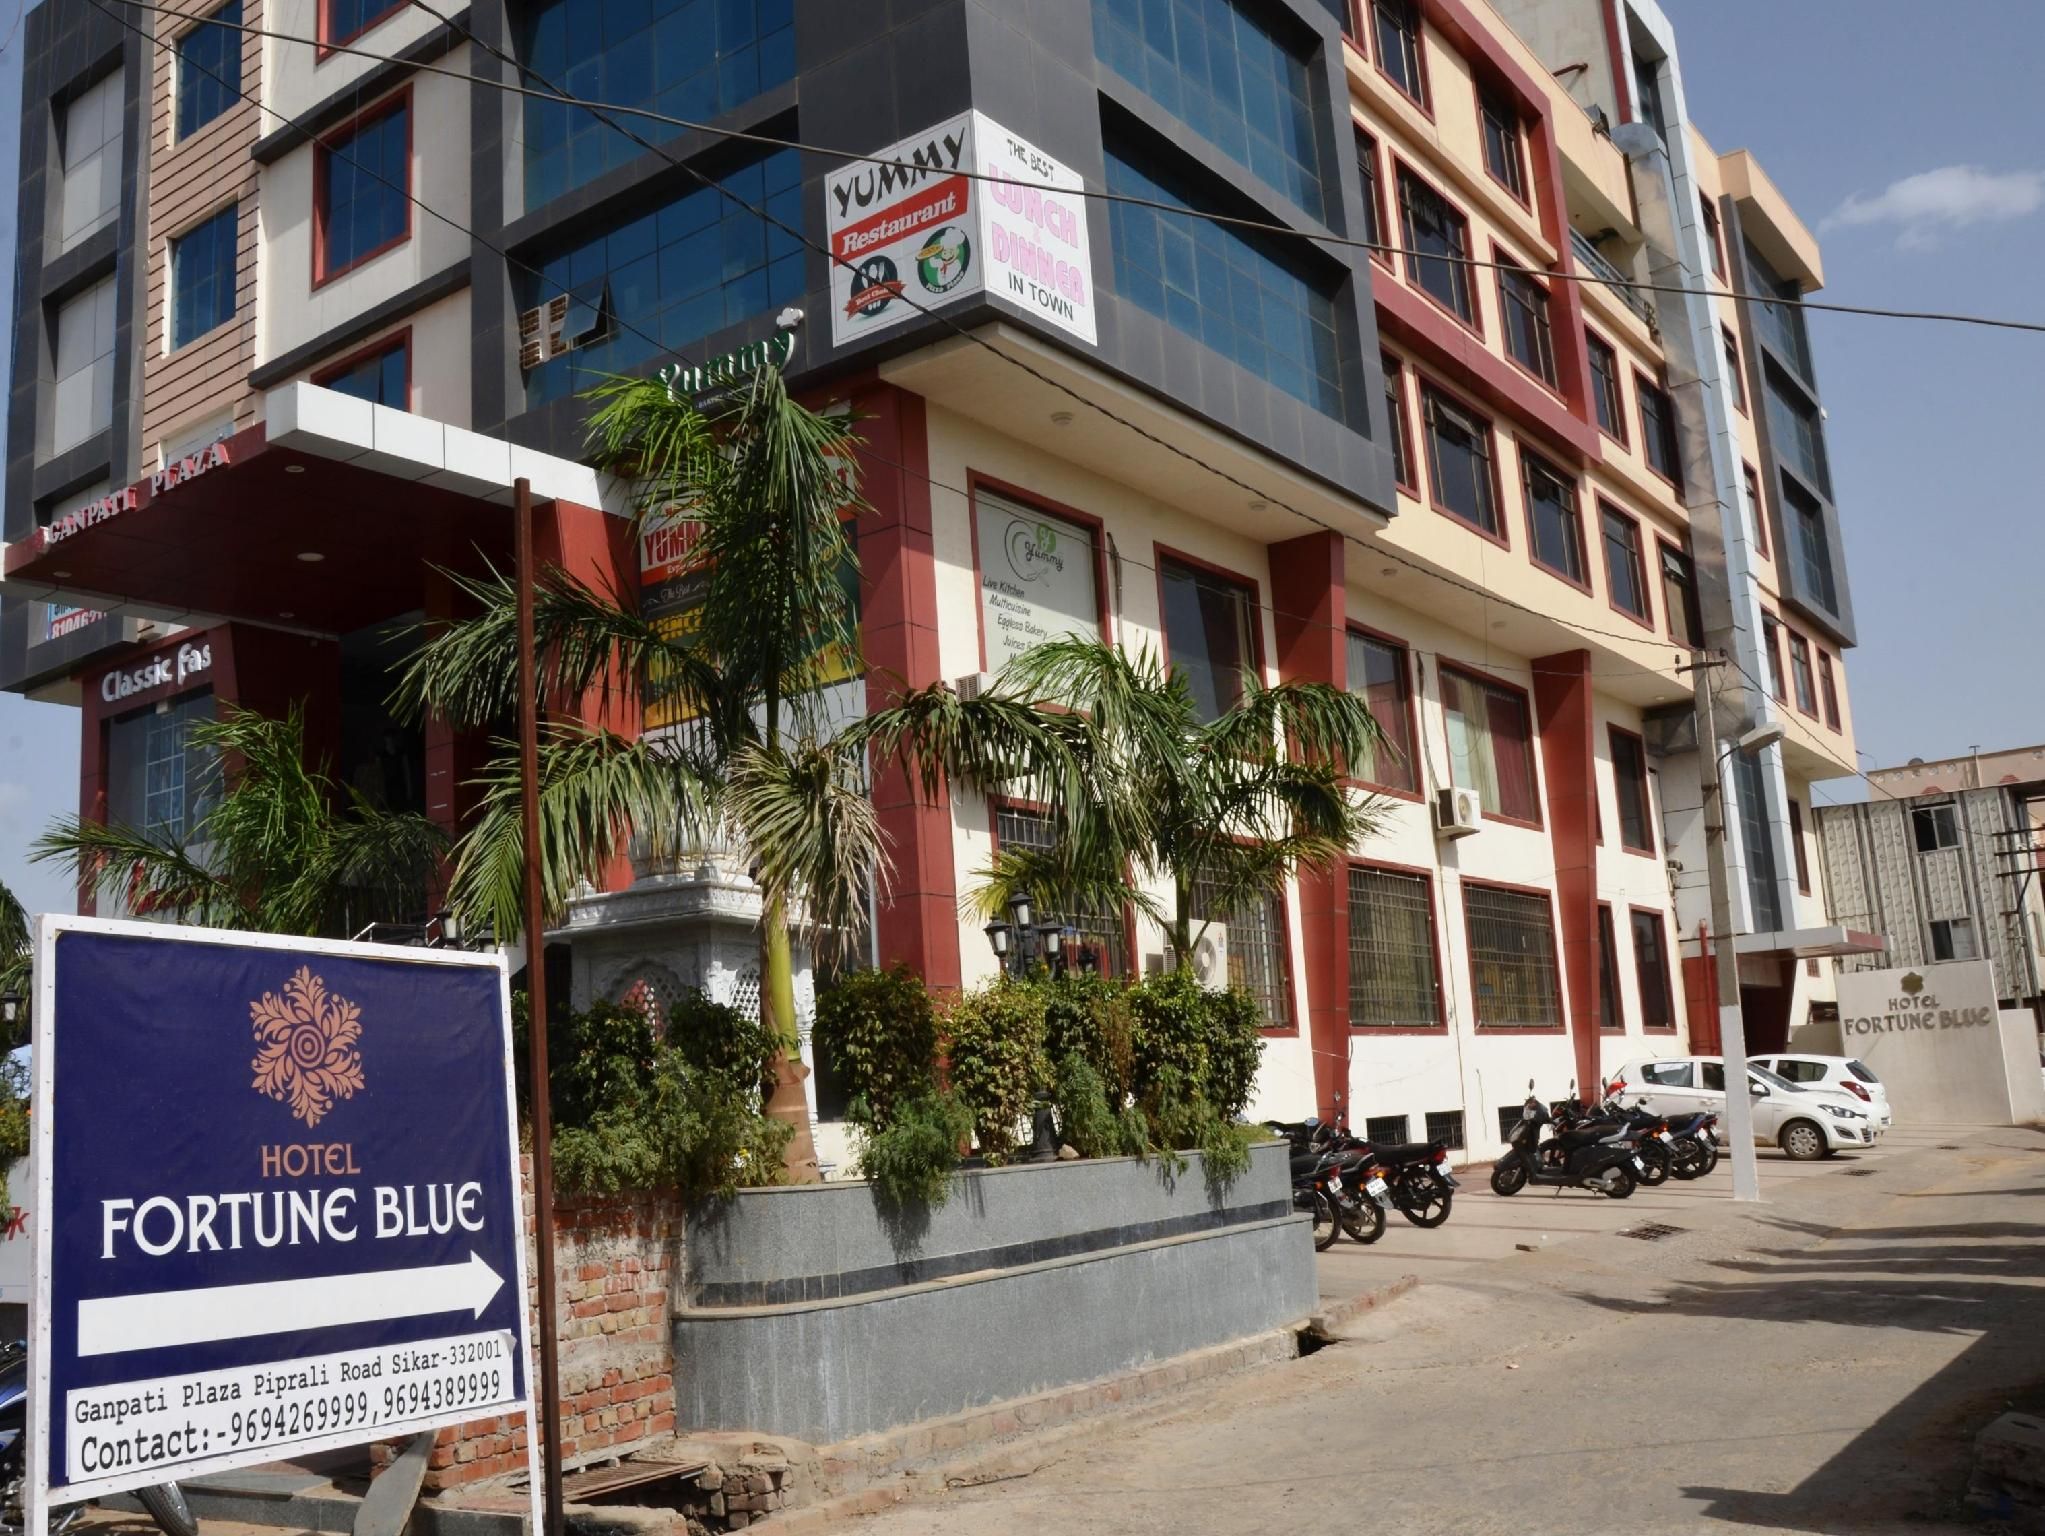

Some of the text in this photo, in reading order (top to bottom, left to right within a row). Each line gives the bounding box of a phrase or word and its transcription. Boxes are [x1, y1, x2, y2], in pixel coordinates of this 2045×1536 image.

[833, 127, 965, 218] YUMMY
[1007, 138, 1054, 181] THE BEST
[841, 191, 956, 256] Restaurant
[988, 163, 1078, 249] LUNCH
[992, 221, 1086, 307] DINNER
[1008, 271, 1073, 321] IN TOWN
[44, 443, 230, 545] GANPATI PLAZA
[644, 521, 704, 566] YUMM
[1024, 541, 1064, 572] Yummy
[983, 575, 1025, 598] Live Kitchen
[989, 593, 1031, 617] Multicuisine
[998, 613, 1047, 639] Eggless Bakery
[1003, 634, 1025, 651] Juices
[102, 654, 172, 702] Classic
[1844, 1006, 1991, 1036] FORTUNE BLUE
[1888, 994, 1940, 1011] HOTEL
[261, 1143, 361, 1178] HOTEL
[100, 1187, 358, 1259] FORTUNE
[373, 1181, 484, 1239] BLUE
[75, 1339, 502, 1425] Ganpati Plaza Piprali Road Sikar-332001
